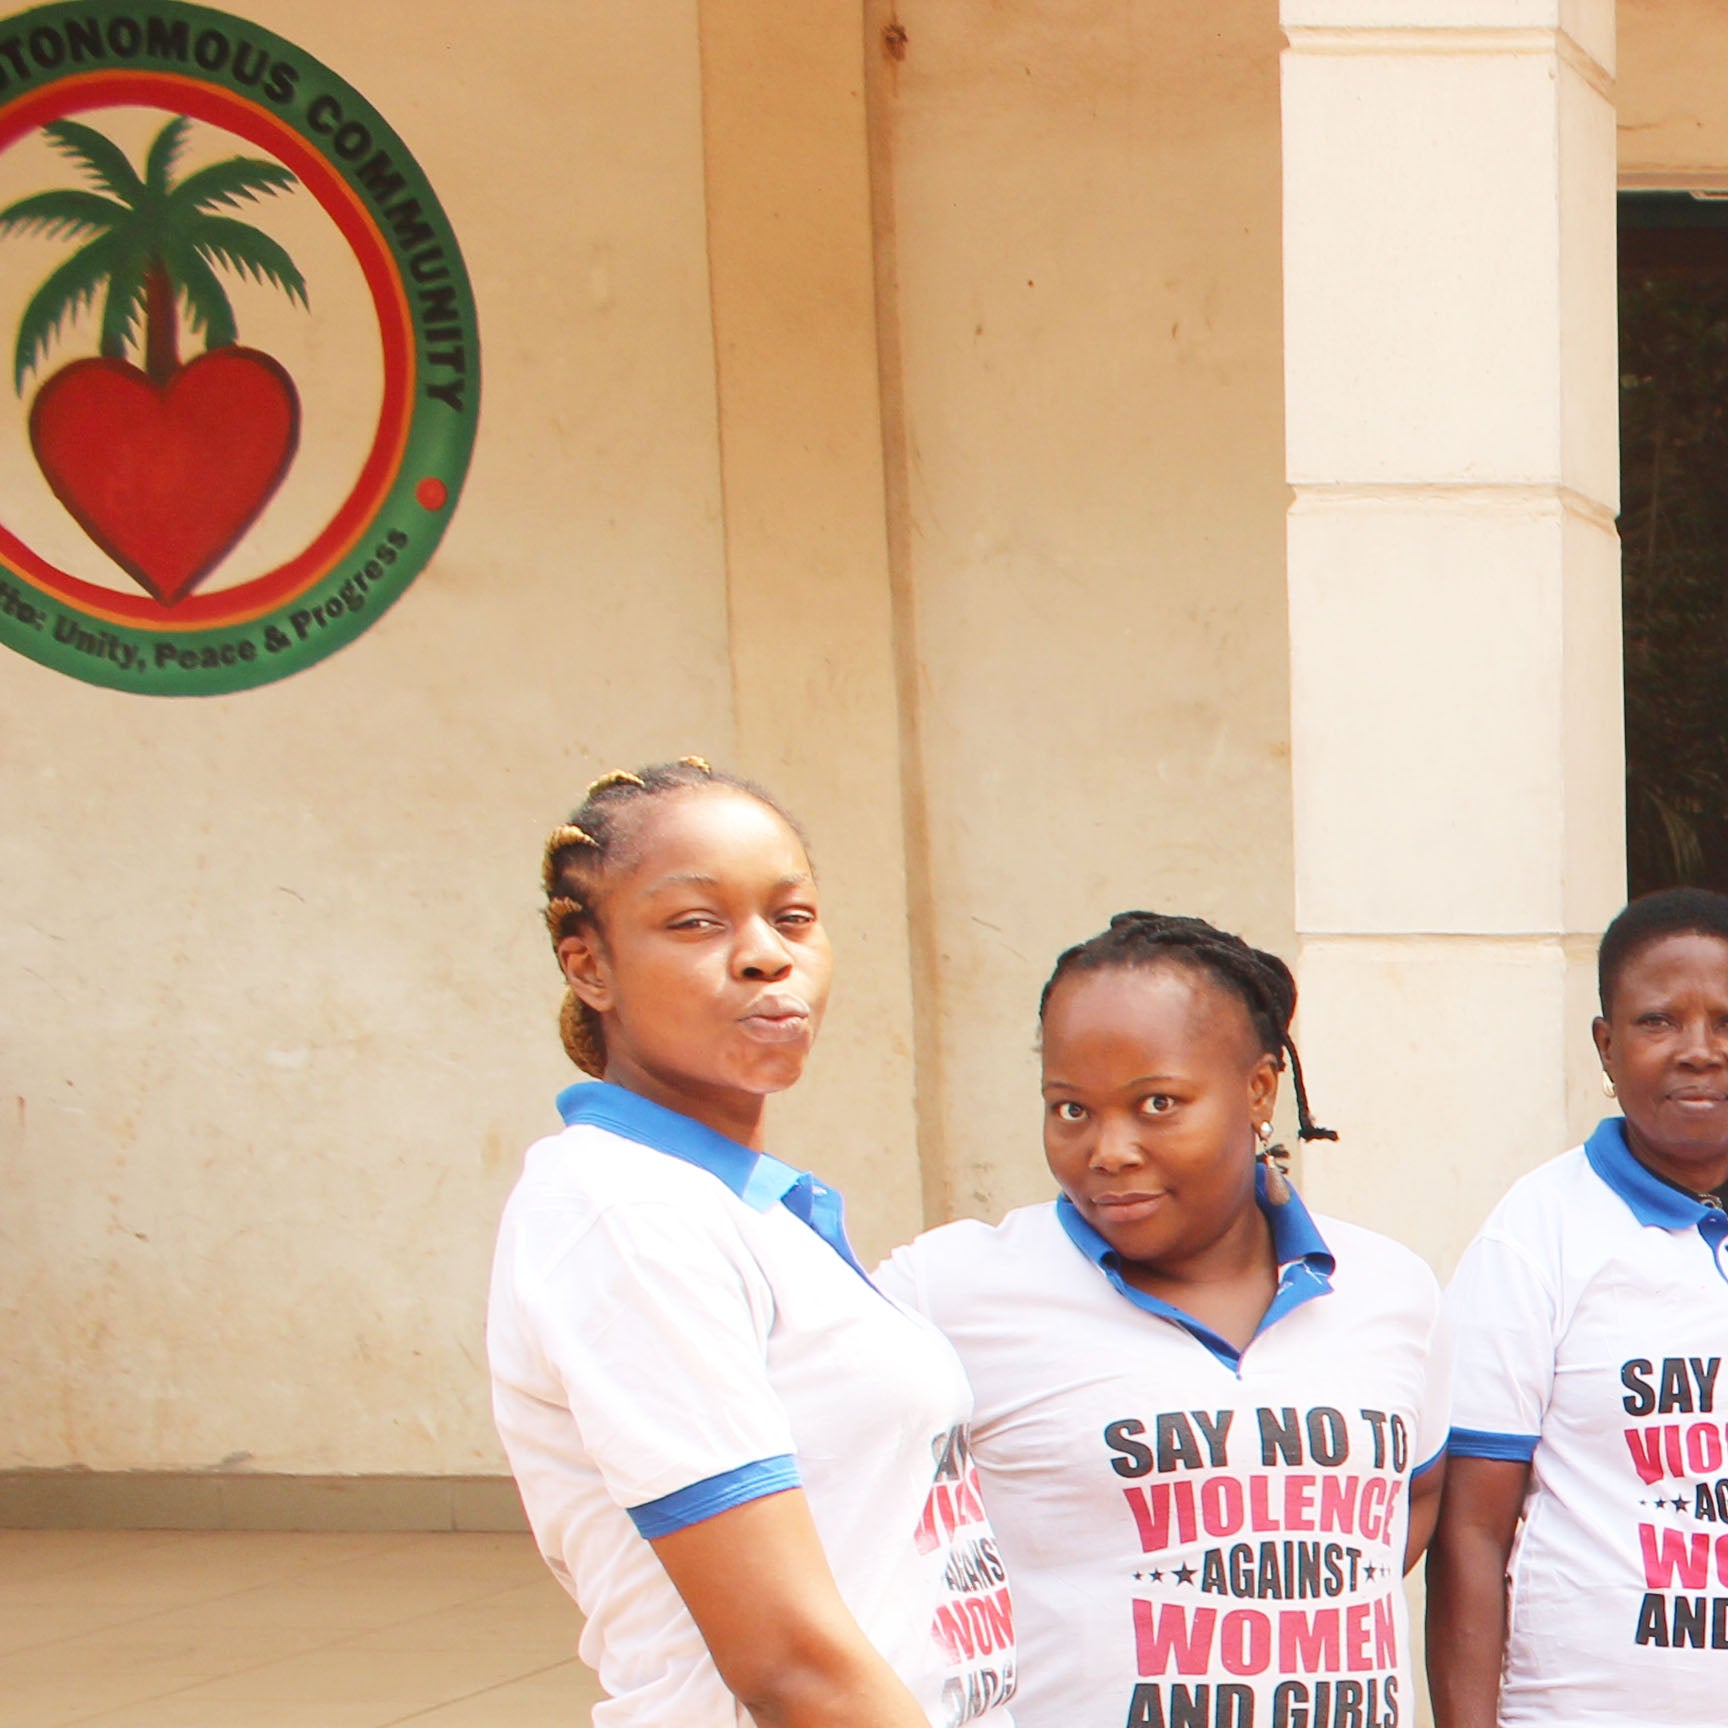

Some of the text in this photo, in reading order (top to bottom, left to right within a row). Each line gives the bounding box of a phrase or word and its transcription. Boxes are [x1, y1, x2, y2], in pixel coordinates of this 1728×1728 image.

[0, 16, 466, 413] TONOMOUS COMMUNITY
[54, 614, 147, 673] Unity,
[154, 637, 258, 670] Peace
[262, 624, 291, 653] &
[290, 527, 408, 642] Progress
[1621, 1357, 1722, 1417] SAY
[1104, 1407, 1408, 1478] SAY NO TO
[1123, 1474, 1403, 1554] VIOLENCE
[1201, 1541, 1361, 1600] AGAINST
[1131, 1591, 1398, 1678] WOMEN
